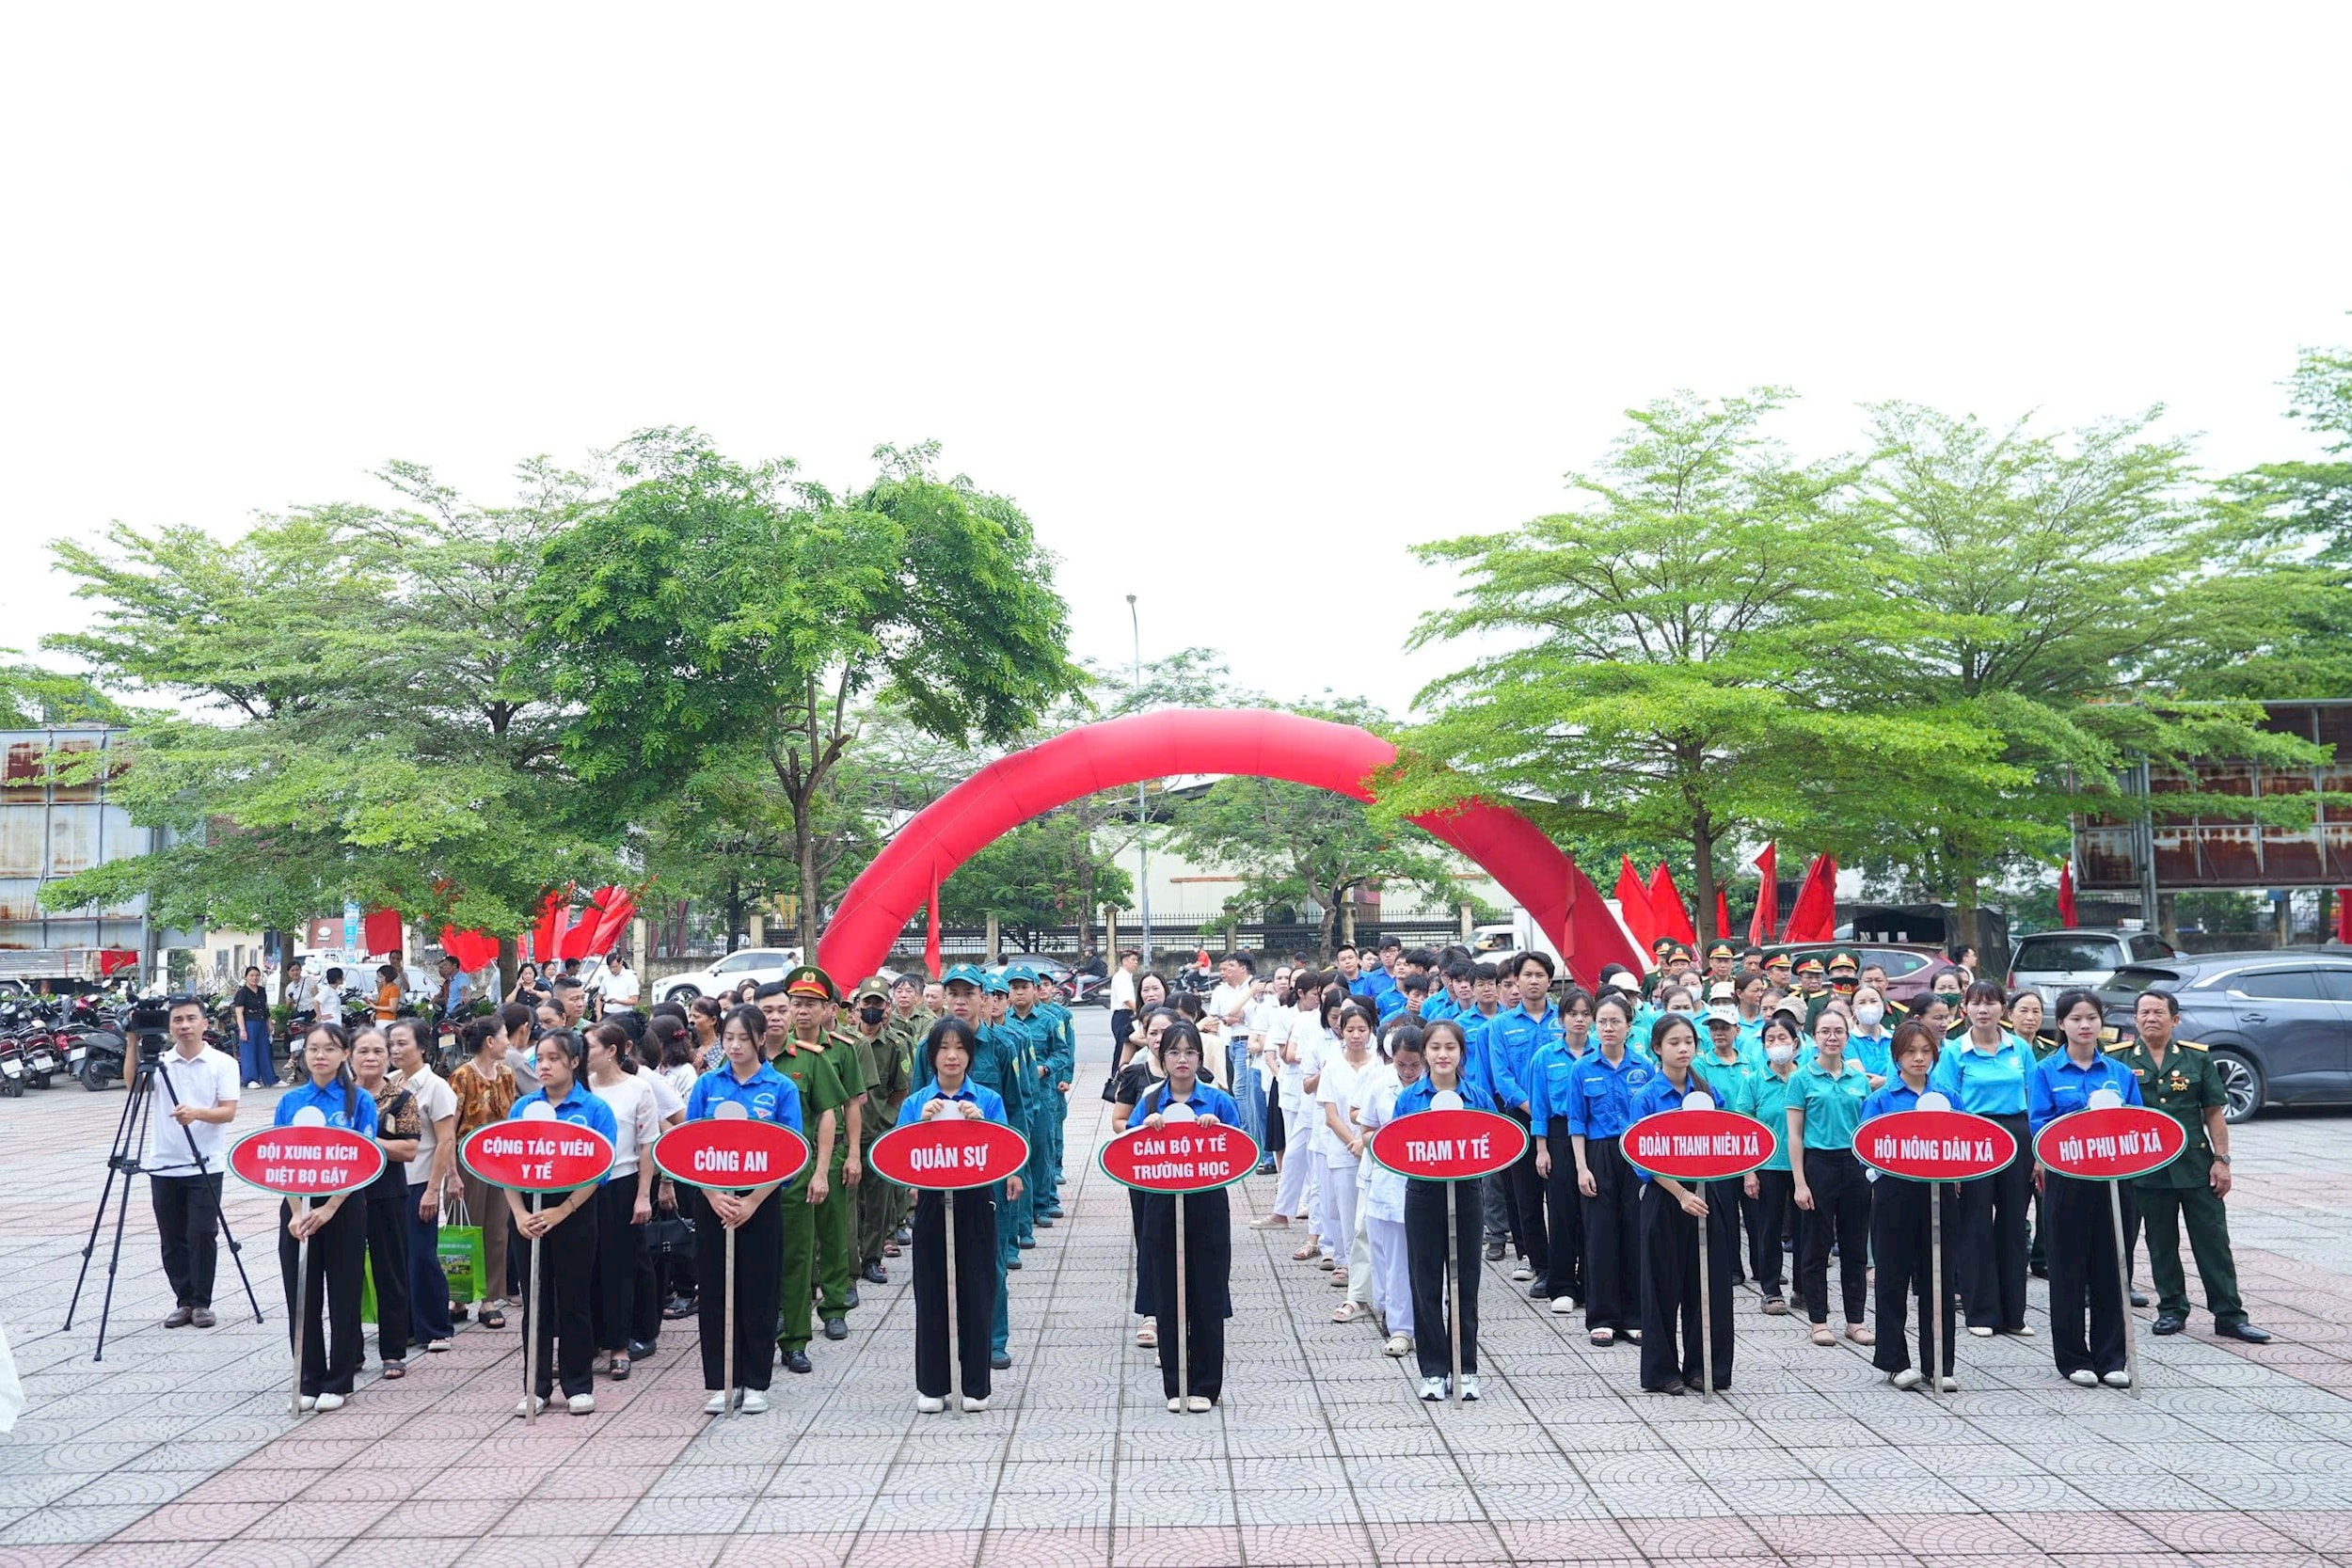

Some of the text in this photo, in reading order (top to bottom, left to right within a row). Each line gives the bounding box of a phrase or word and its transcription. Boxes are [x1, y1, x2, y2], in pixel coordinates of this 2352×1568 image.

[257, 1143, 358, 1163] ĐỘI XUNG KÍCH
[483, 1136, 595, 1158] CỘNG TÁC VIÊN
[1133, 1132, 1227, 1157] CÁN BỘ Y TẾ
[1406, 1132, 1491, 1165] TRẠM Y TẾ
[1638, 1132, 1759, 1156] ĐOÀN THANH NIÊN XÃ
[1874, 1134, 1994, 1164] HỘI NÔNG DÂN XÃ
[2058, 1128, 2163, 1165] HỘI PHỤ NỮ XÃ
[694, 1146, 768, 1172] CÔNG AN
[910, 1143, 989, 1171] QUÂN SỰ
[265, 1166, 348, 1187] DIỆT BỌ GẬY
[521, 1161, 554, 1180] Y TẾ
[1132, 1161, 1230, 1180] TRƯỜNG HỌC
